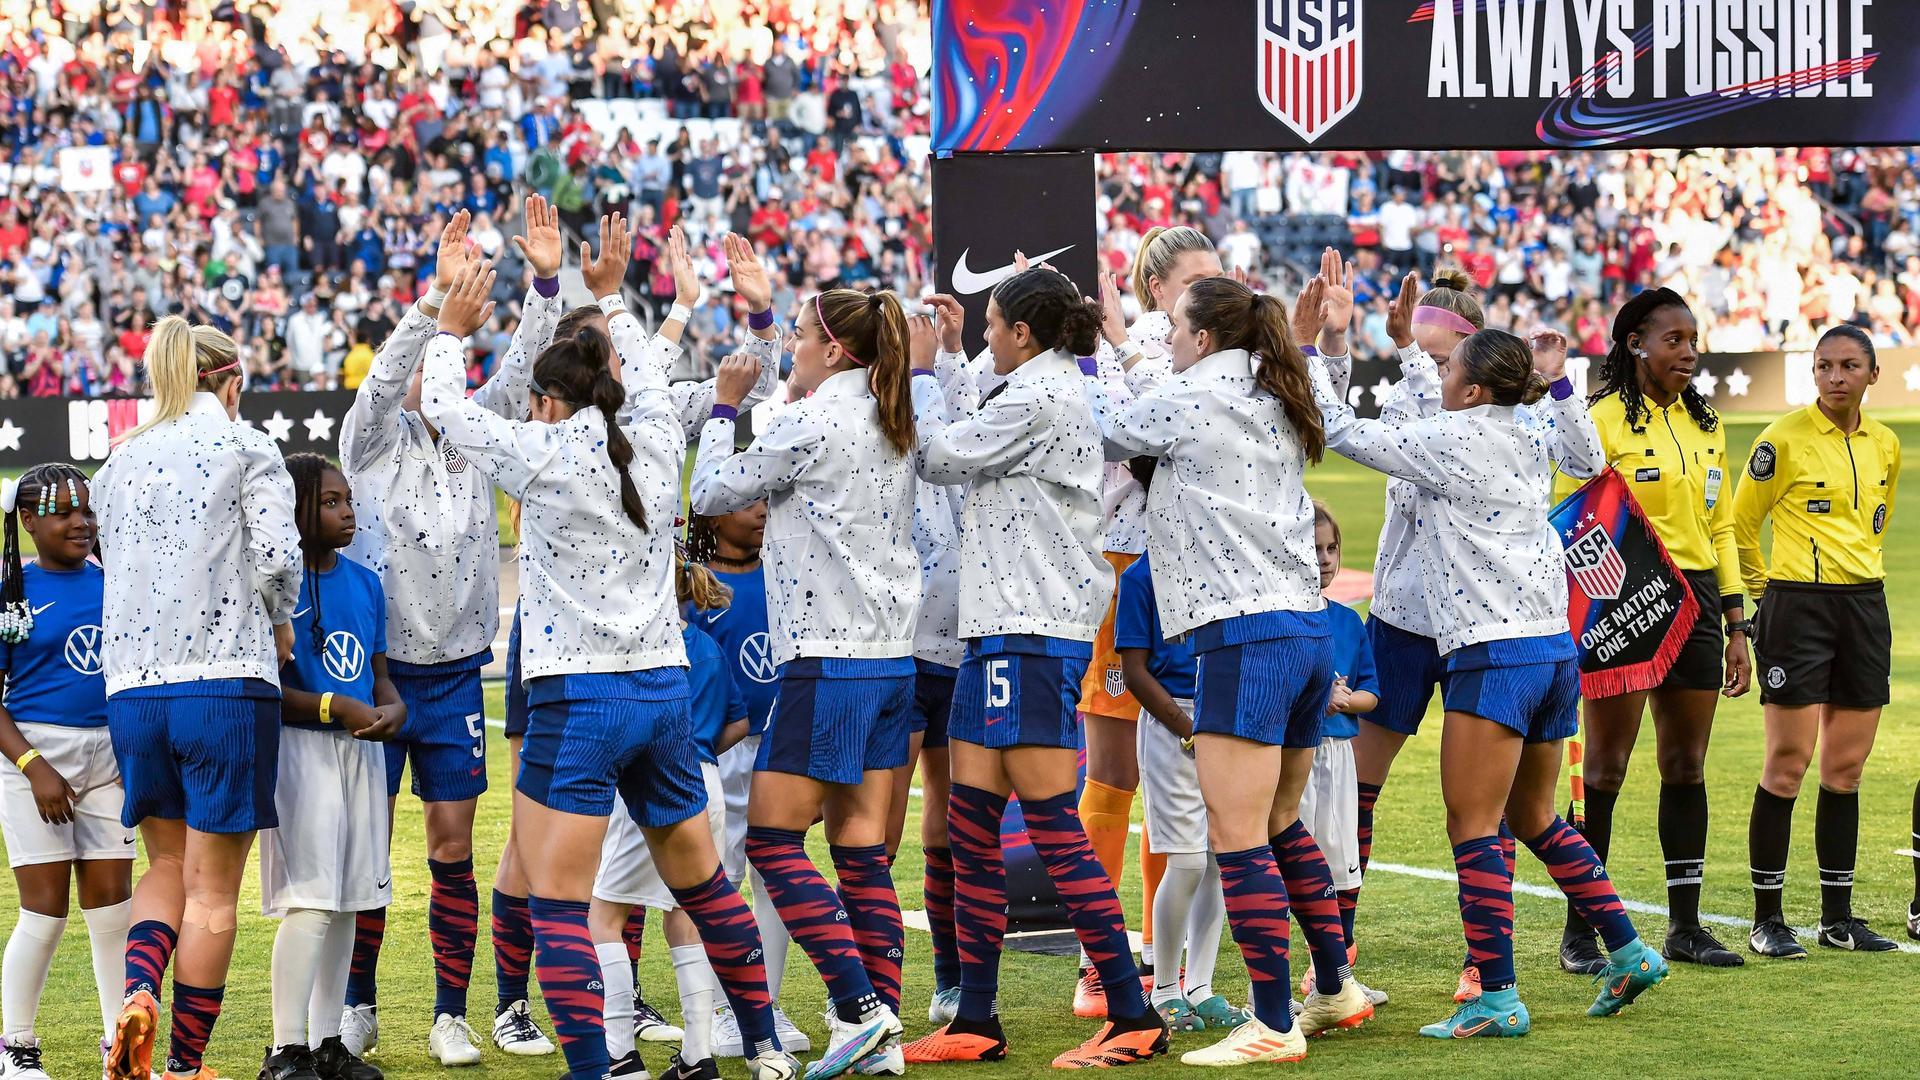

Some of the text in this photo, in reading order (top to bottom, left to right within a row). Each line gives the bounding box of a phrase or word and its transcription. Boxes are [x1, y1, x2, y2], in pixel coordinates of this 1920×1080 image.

[1265, 0, 1355, 51] USA
[1427, 0, 1873, 98] ALWAYS POSSIBLE
[1708, 469, 1721, 480] FIFA
[1565, 529, 1609, 570] USA
[1580, 575, 1671, 651] ONE NATION.
[1596, 597, 1675, 663] ONE TEAM.
[986, 660, 1010, 708] 15
[465, 712, 484, 758] 5
